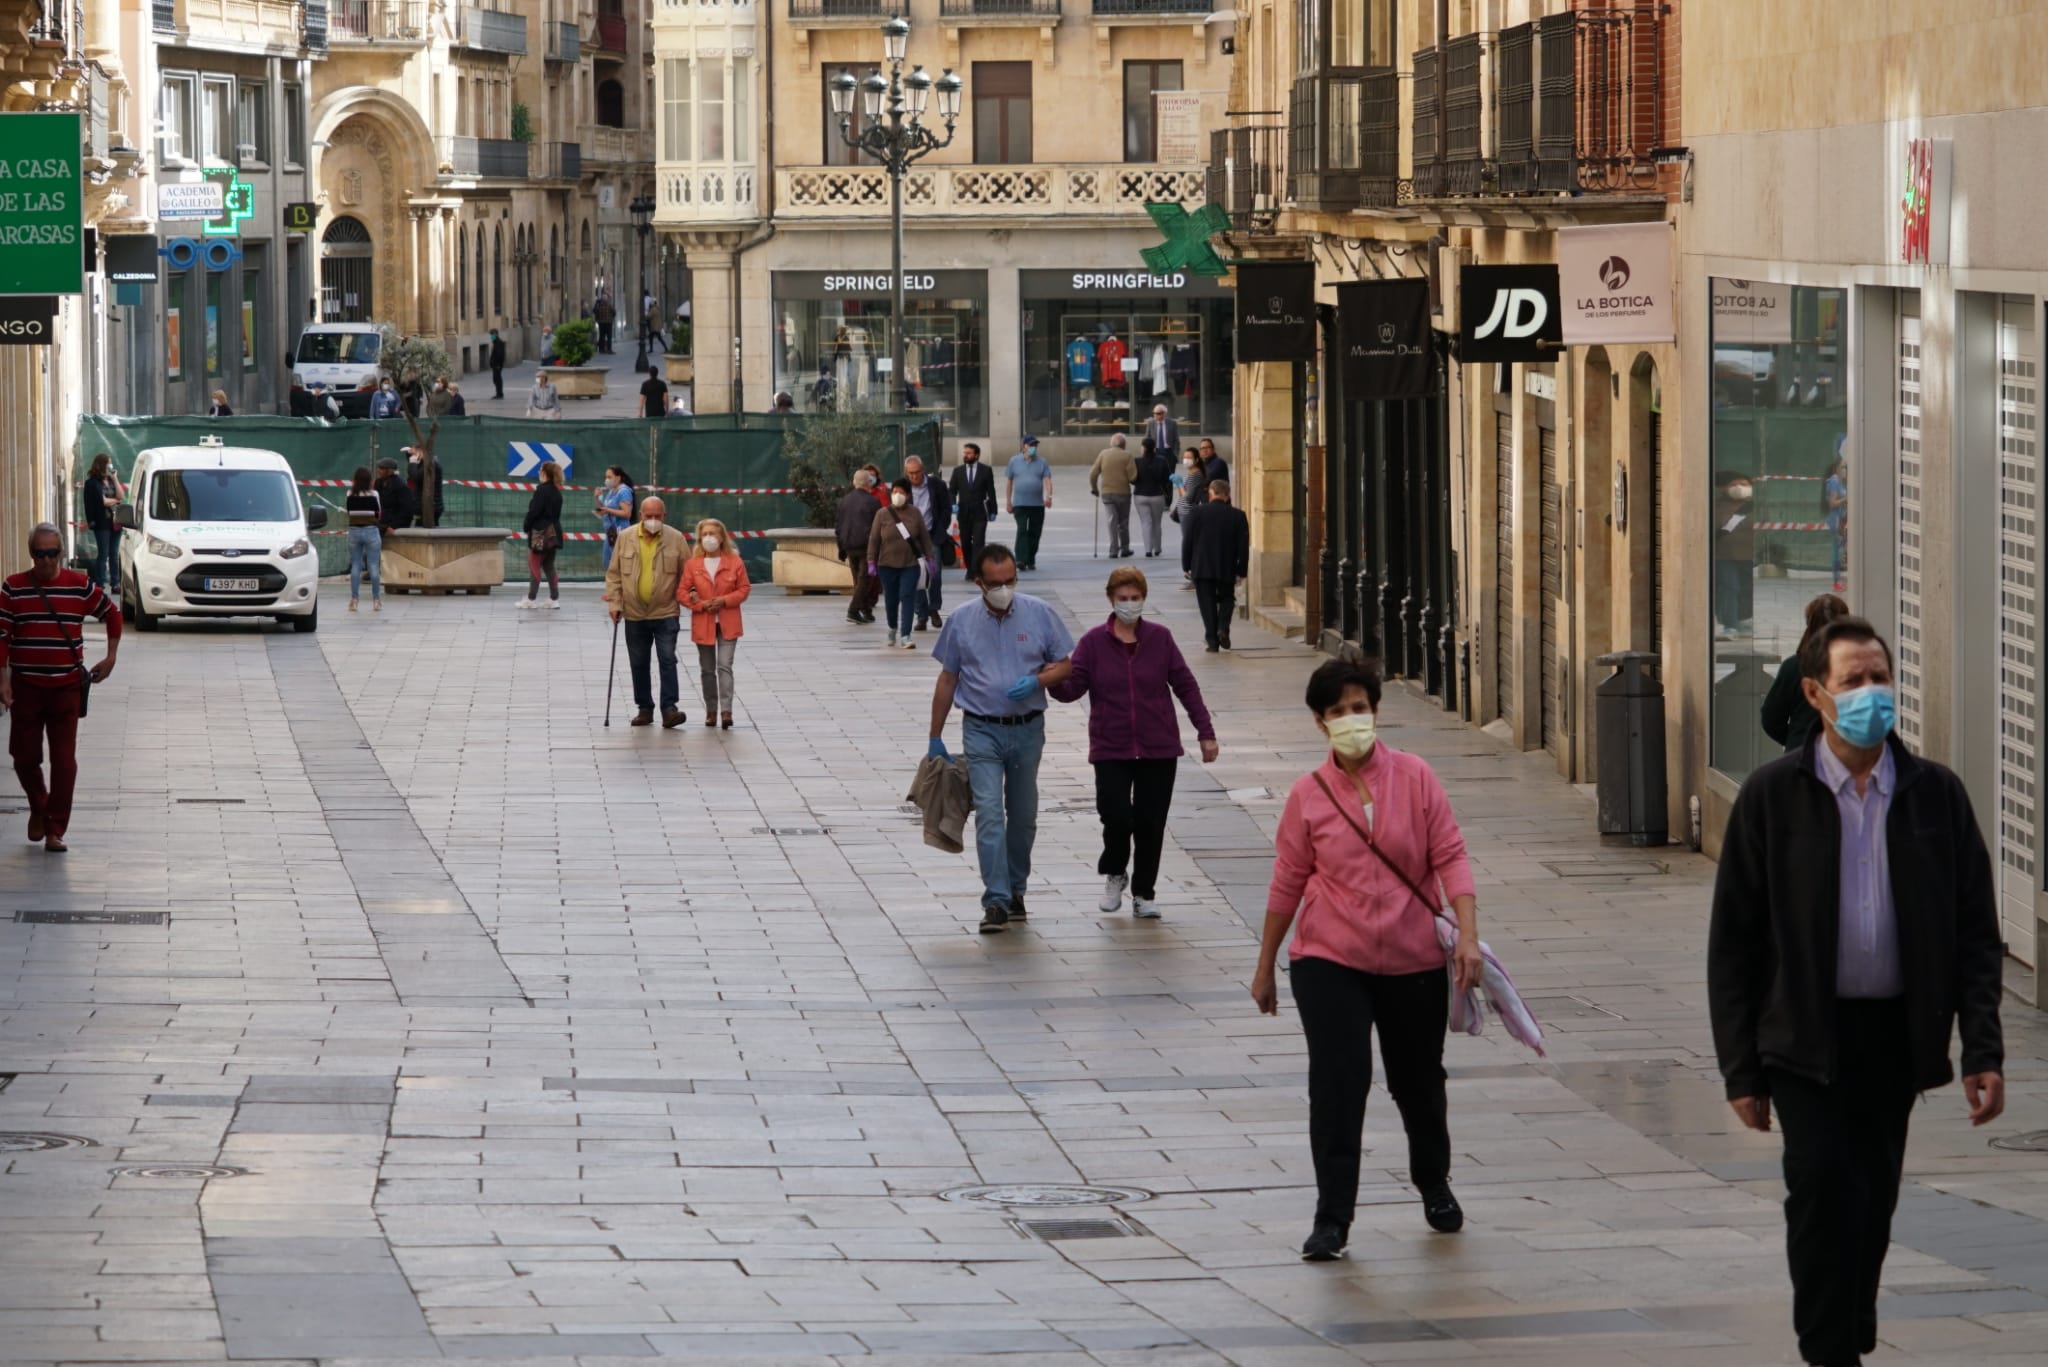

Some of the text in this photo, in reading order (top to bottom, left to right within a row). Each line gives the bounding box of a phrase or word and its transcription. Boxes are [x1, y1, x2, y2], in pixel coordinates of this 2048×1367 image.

[16, 159, 72, 178] CASA
[166, 186, 216, 196] ACADEMIA
[23, 191, 65, 211] LAS
[171, 198, 211, 208] GALILEO
[113, 272, 156, 280] CALZEDONIA
[823, 275, 935, 291] SPRINGELD
[1072, 273, 1185, 289] SPRINGFIELD
[1577, 295, 1654, 310] LA BOTICA
[1474, 288, 1548, 339] JD
[1610, 309, 1646, 317] PERFUMES
[1351, 344, 1423, 357] Massimo Dutti
[212, 579, 257, 590] 4397 KHD
